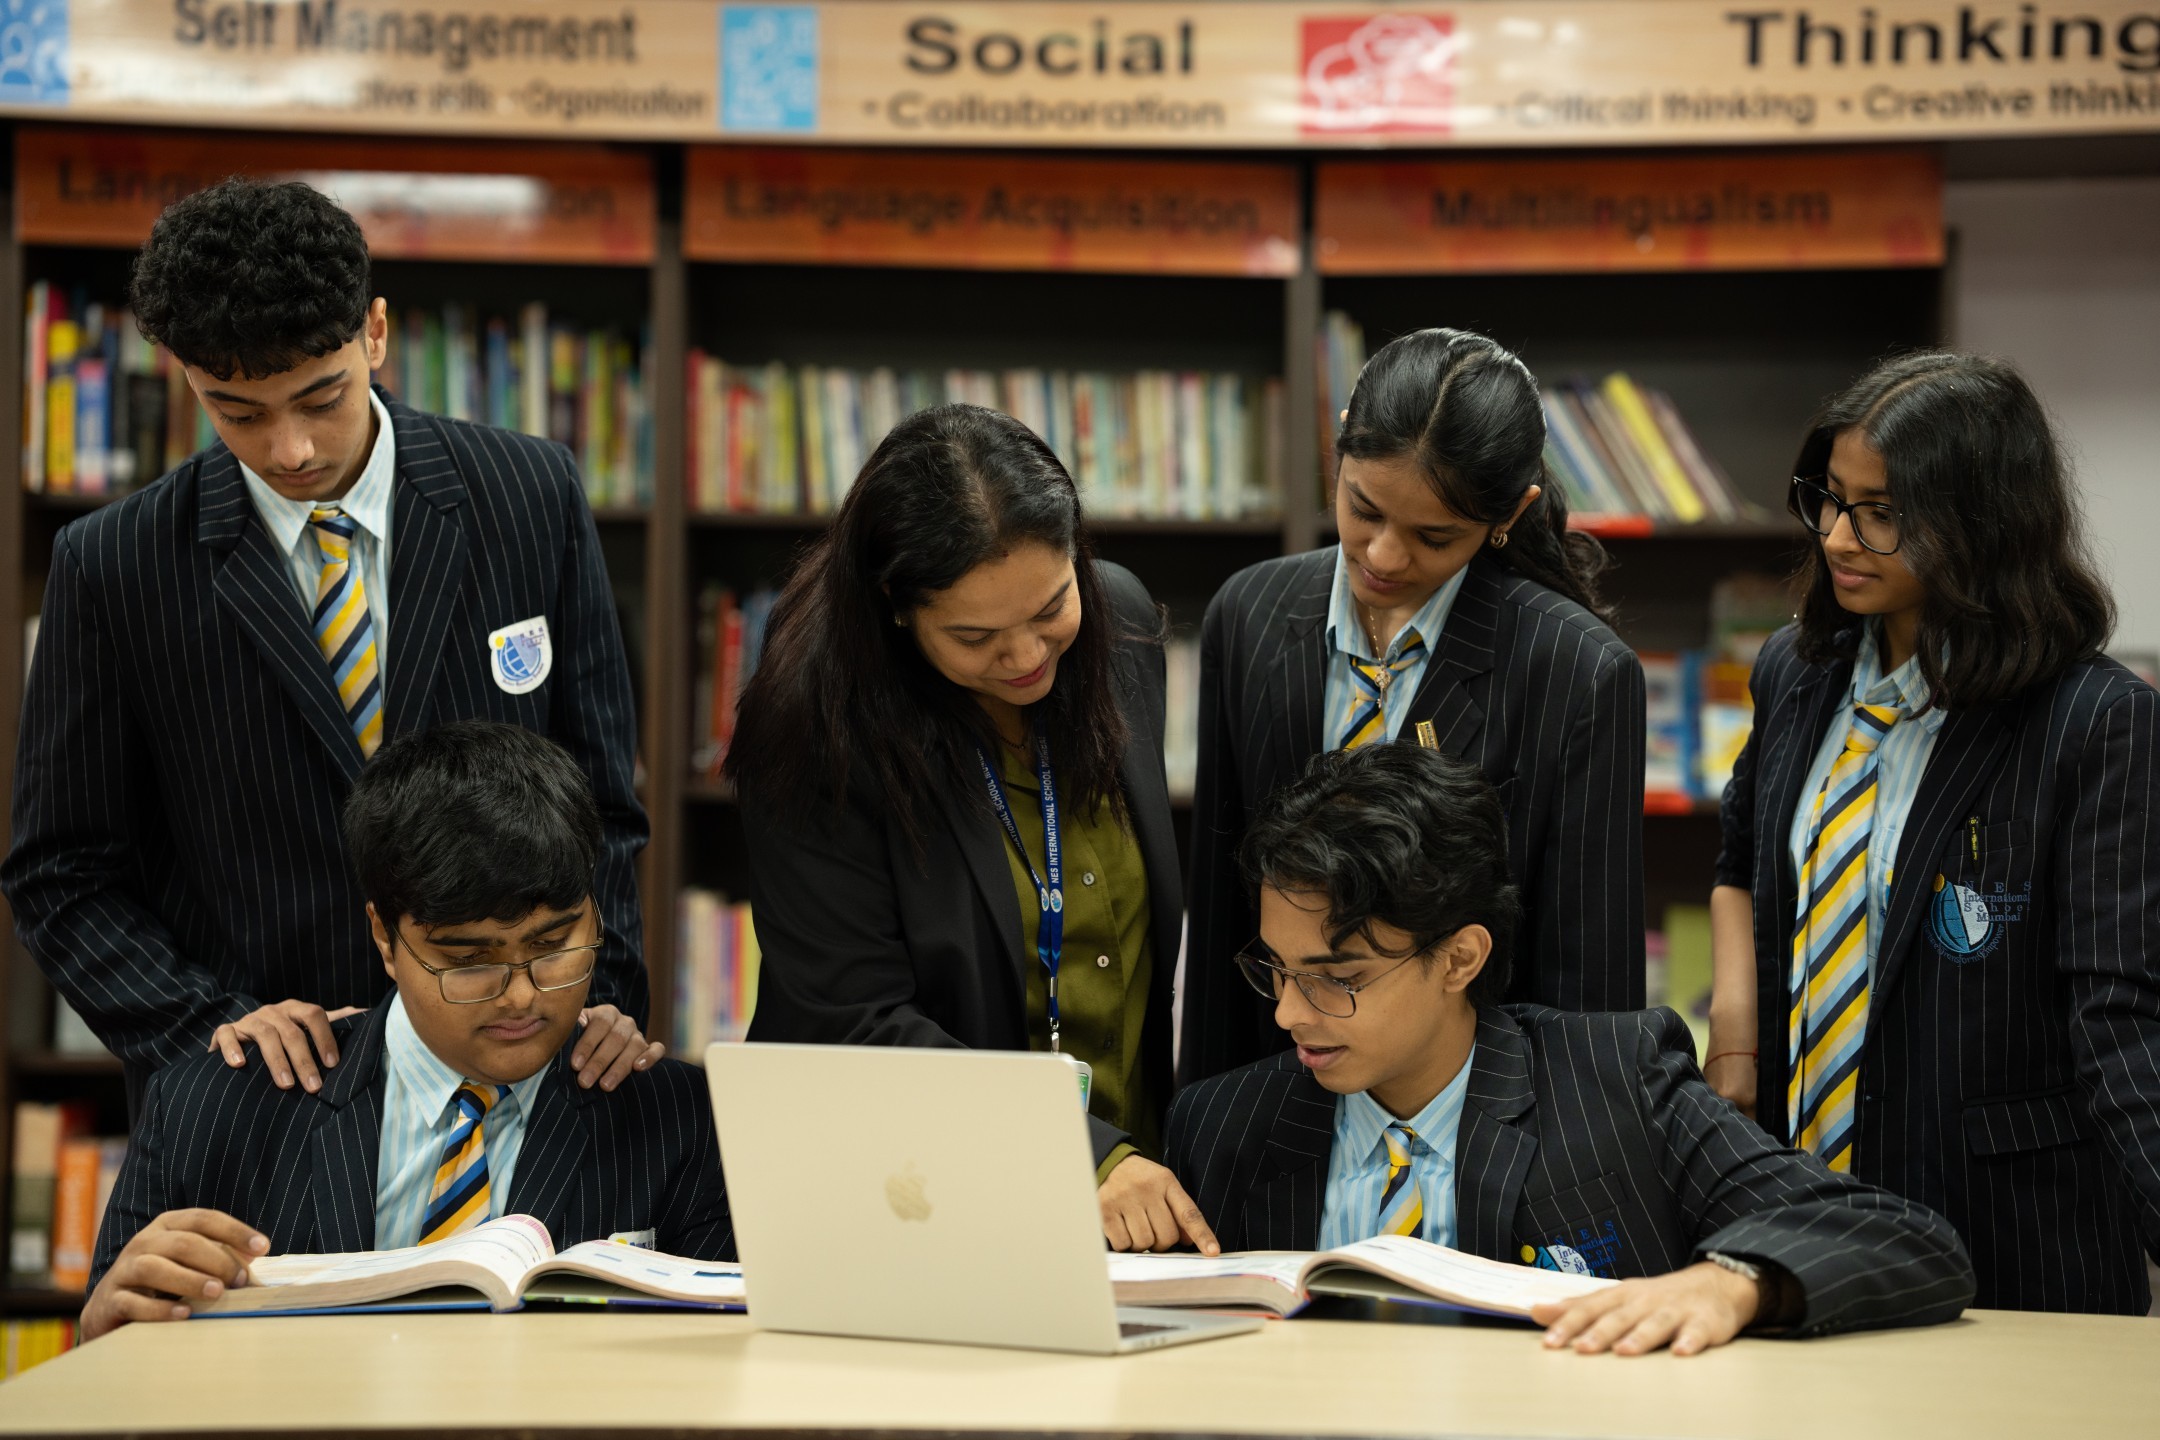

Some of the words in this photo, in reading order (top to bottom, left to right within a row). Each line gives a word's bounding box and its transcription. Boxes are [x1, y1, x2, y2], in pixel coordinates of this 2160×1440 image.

[174, 0, 281, 47] Self
[296, 0, 639, 74] Management
[904, 17, 1195, 77] Social
[1724, 5, 2160, 72] Thinking
[886, 90, 1226, 131] Collaboration
[1514, 89, 1654, 128] Critical
[1661, 88, 1816, 126] thinking
[1862, 82, 2035, 121] Creative
[724, 177, 966, 236] Language
[979, 183, 1260, 236] Acquisition
[1431, 187, 1831, 236] Multilingualism
[1042, 769, 1055, 801] SCHOOL
[1046, 803, 1059, 866] INTERNATIONAL
[1051, 867, 1060, 883] NES
[1964, 892, 2031, 903] International
[1976, 912, 2021, 922] Mumbai
